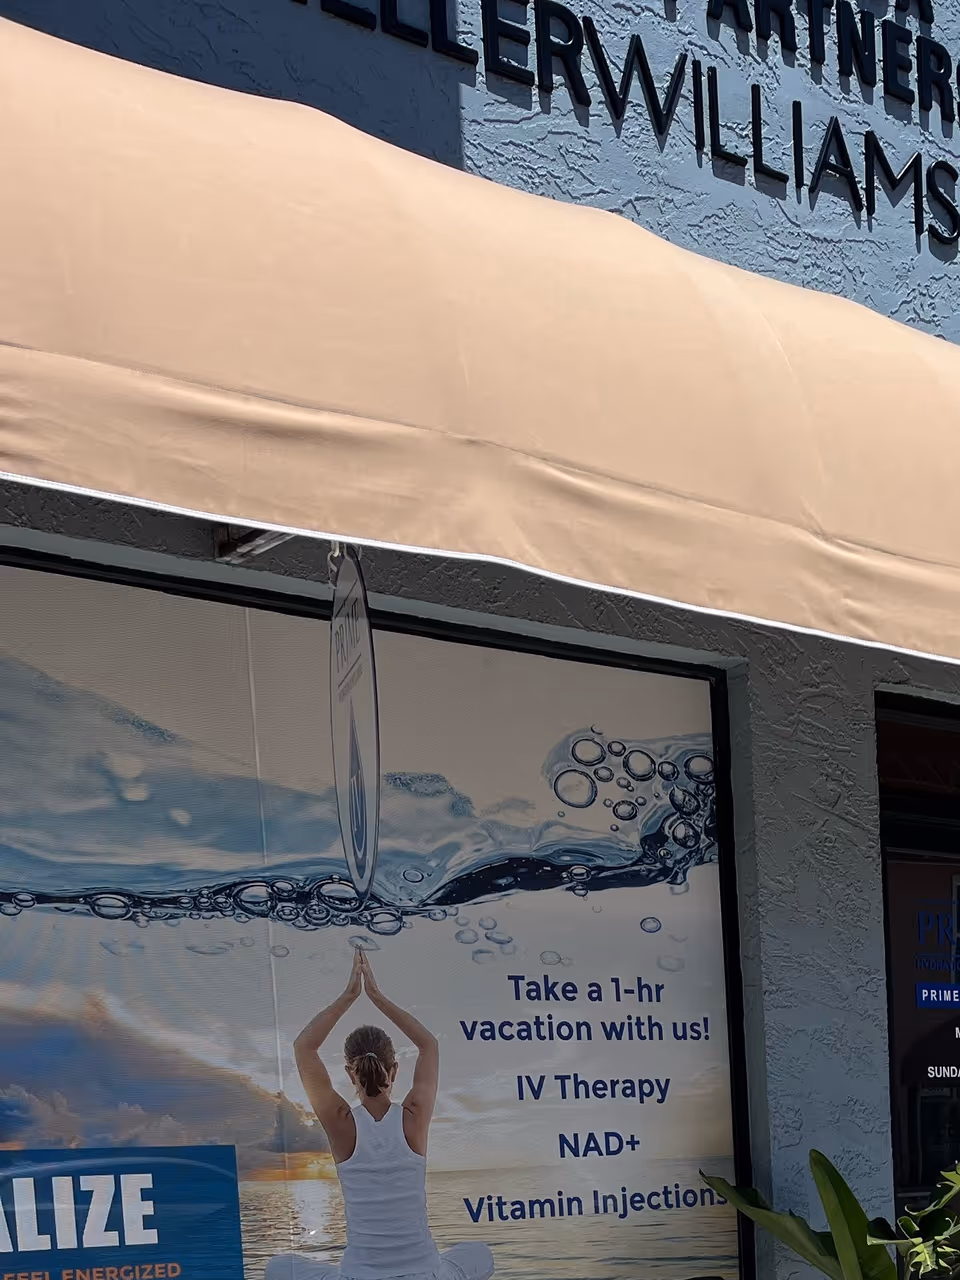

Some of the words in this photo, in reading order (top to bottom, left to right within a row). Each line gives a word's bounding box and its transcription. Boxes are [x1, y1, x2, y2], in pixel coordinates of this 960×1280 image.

[507, 974, 579, 1002] Take
[587, 982, 602, 1002] a
[611, 977, 665, 1002] 1-hr
[459, 1013, 593, 1041] vacation
[600, 1015, 664, 1041] with
[672, 1017, 710, 1041] us!
[516, 1075, 546, 1101] IV
[554, 1073, 671, 1104] Therapy
[558, 1131, 640, 1158] NAD+
[463, 1190, 583, 1223] Vitamin
